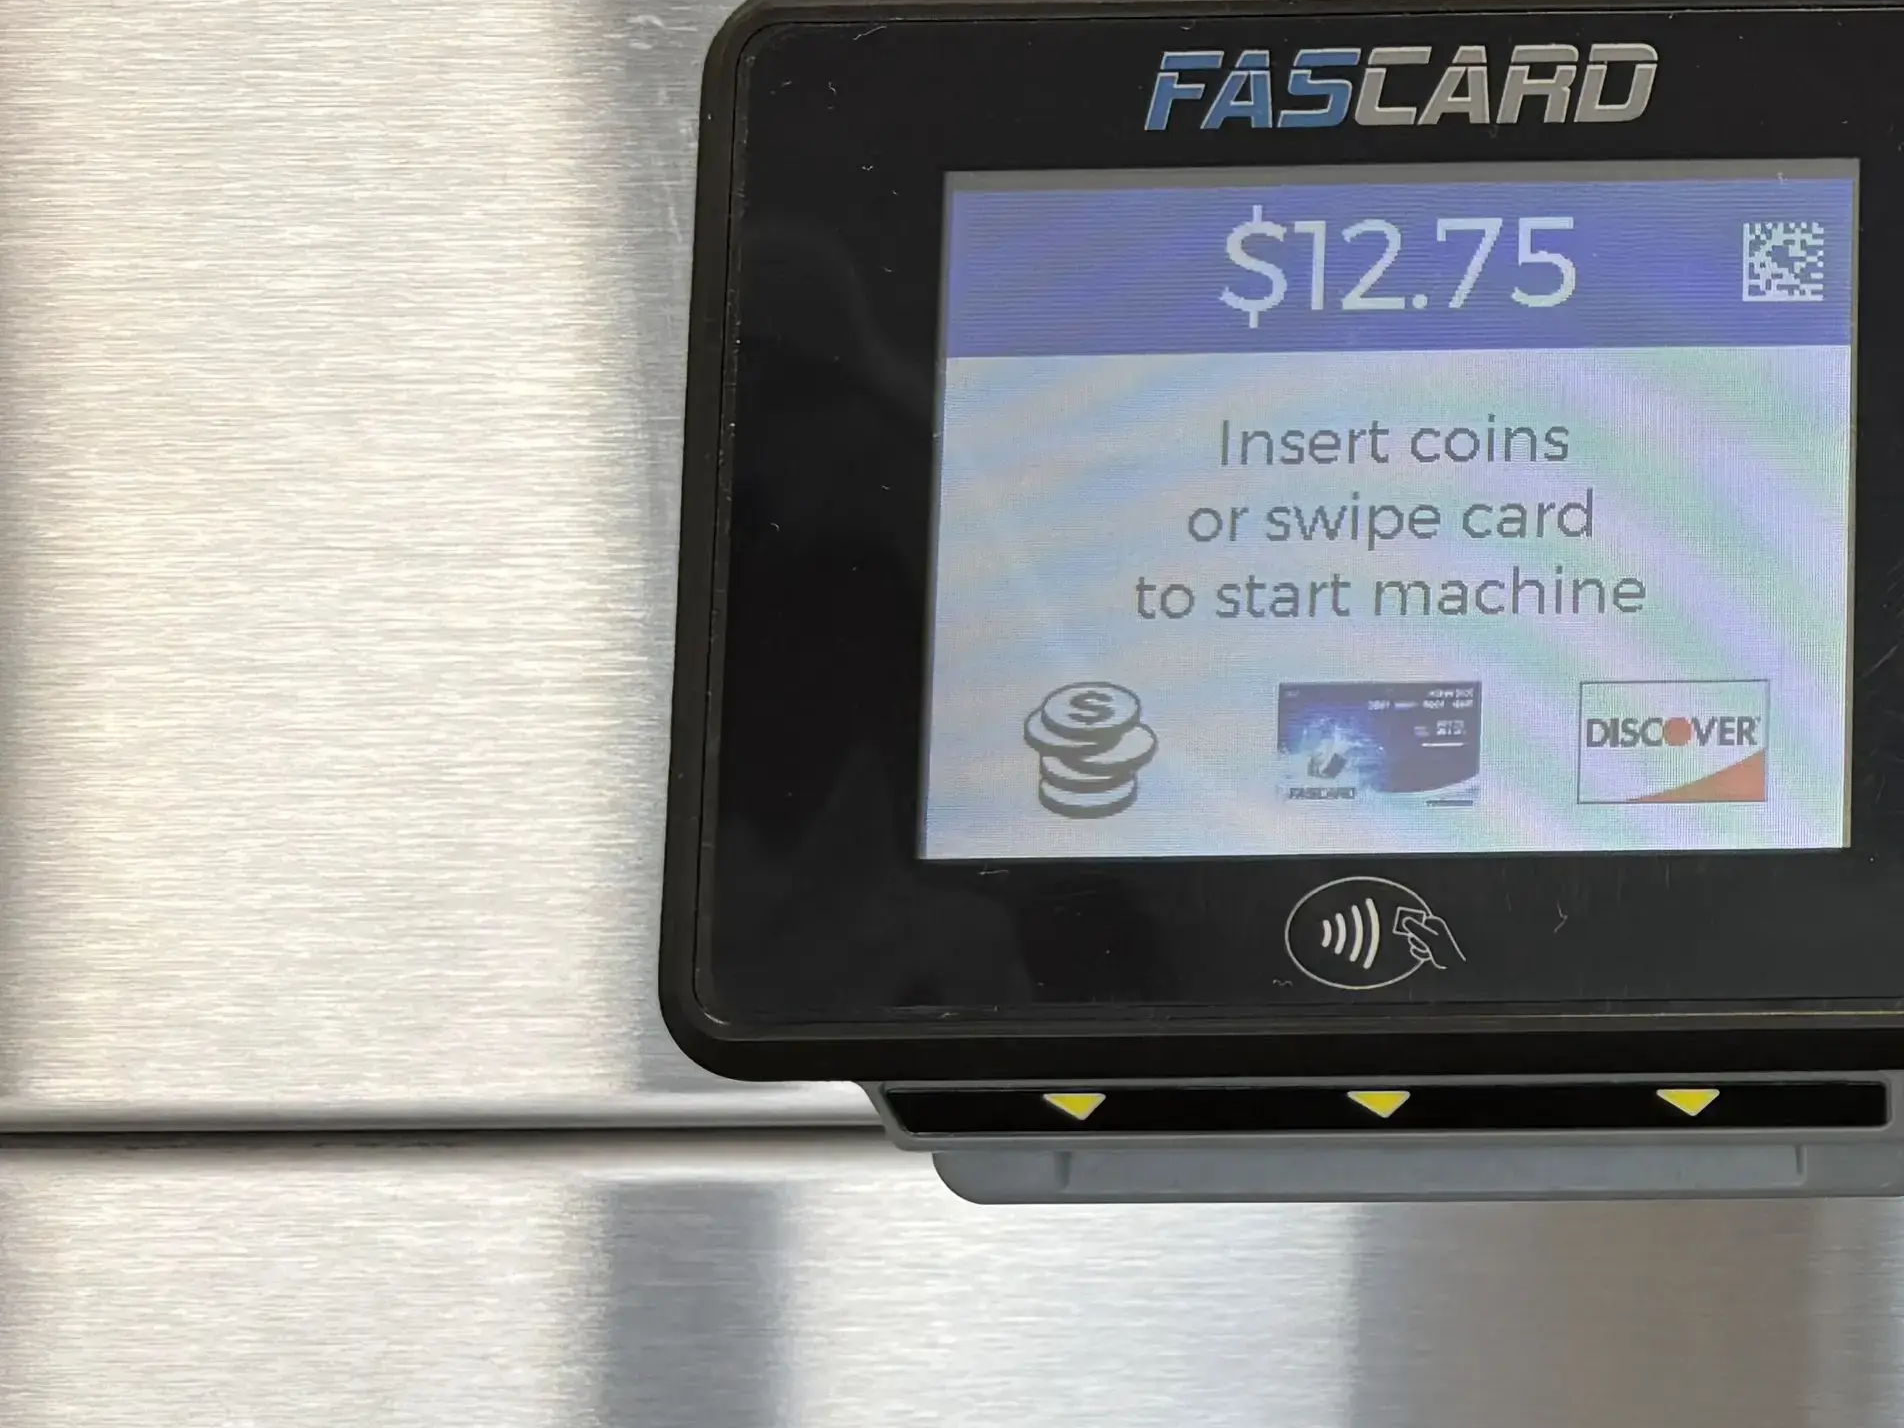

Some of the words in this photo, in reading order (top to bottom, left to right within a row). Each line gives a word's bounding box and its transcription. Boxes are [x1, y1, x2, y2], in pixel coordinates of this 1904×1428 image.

[1144, 43, 1659, 131] FASCARD
[1218, 204, 1576, 329] $12.75
[1220, 419, 1390, 466] Insert
[1410, 413, 1570, 463] coins
[1188, 506, 1250, 543] or
[1265, 490, 1441, 552] swipe
[1461, 487, 1594, 539] card
[1135, 576, 1196, 620] to
[1215, 572, 1352, 619] start
[1374, 564, 1646, 617] machine
[1585, 714, 1762, 748] DISCOVER
